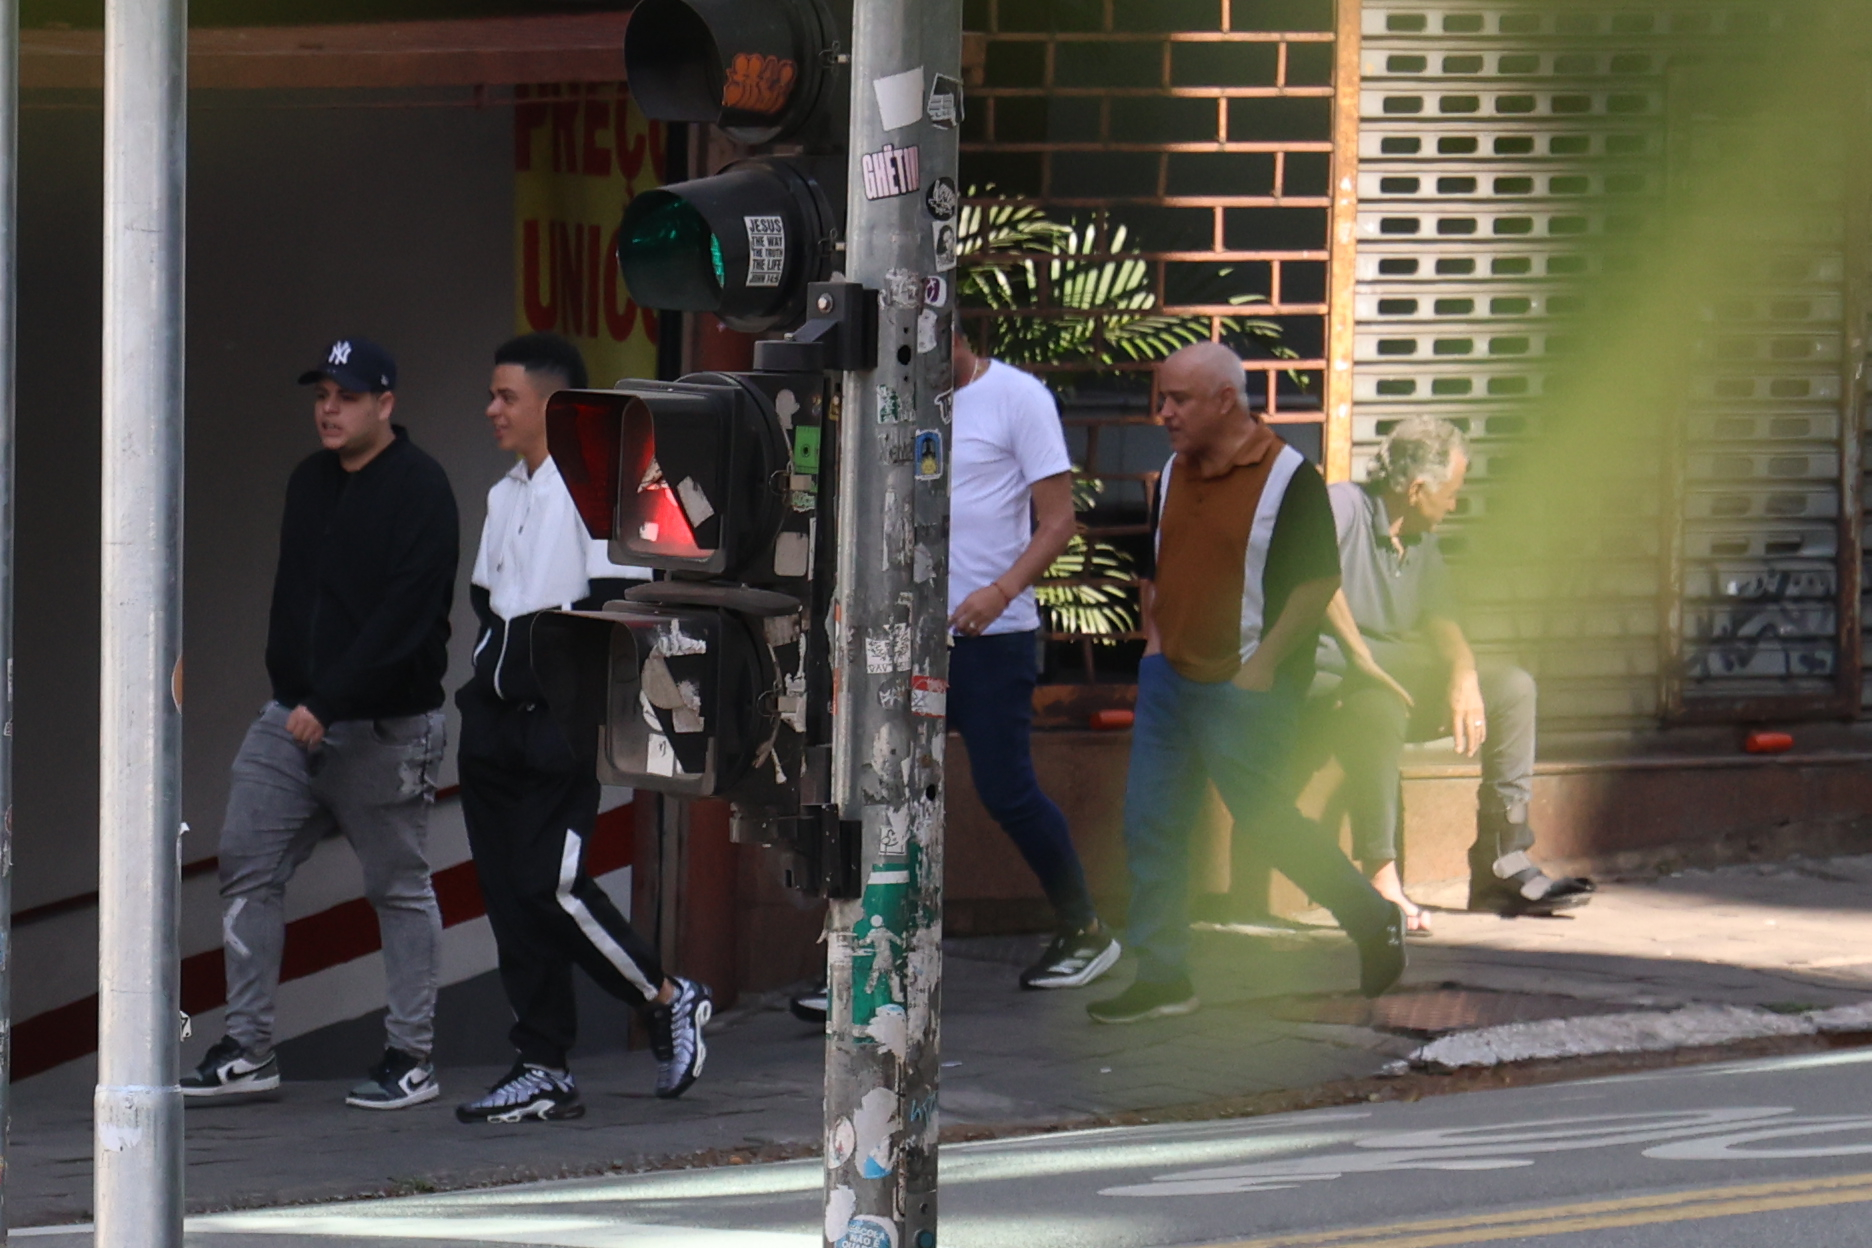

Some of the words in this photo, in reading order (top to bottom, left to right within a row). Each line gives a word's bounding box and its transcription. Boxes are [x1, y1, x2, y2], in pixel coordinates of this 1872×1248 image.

[749, 218, 782, 233] JESUS
[751, 236, 765, 247] THE
[767, 236, 783, 247] WAY
[752, 259, 765, 271] THE
[523, 218, 658, 346] UNIC
